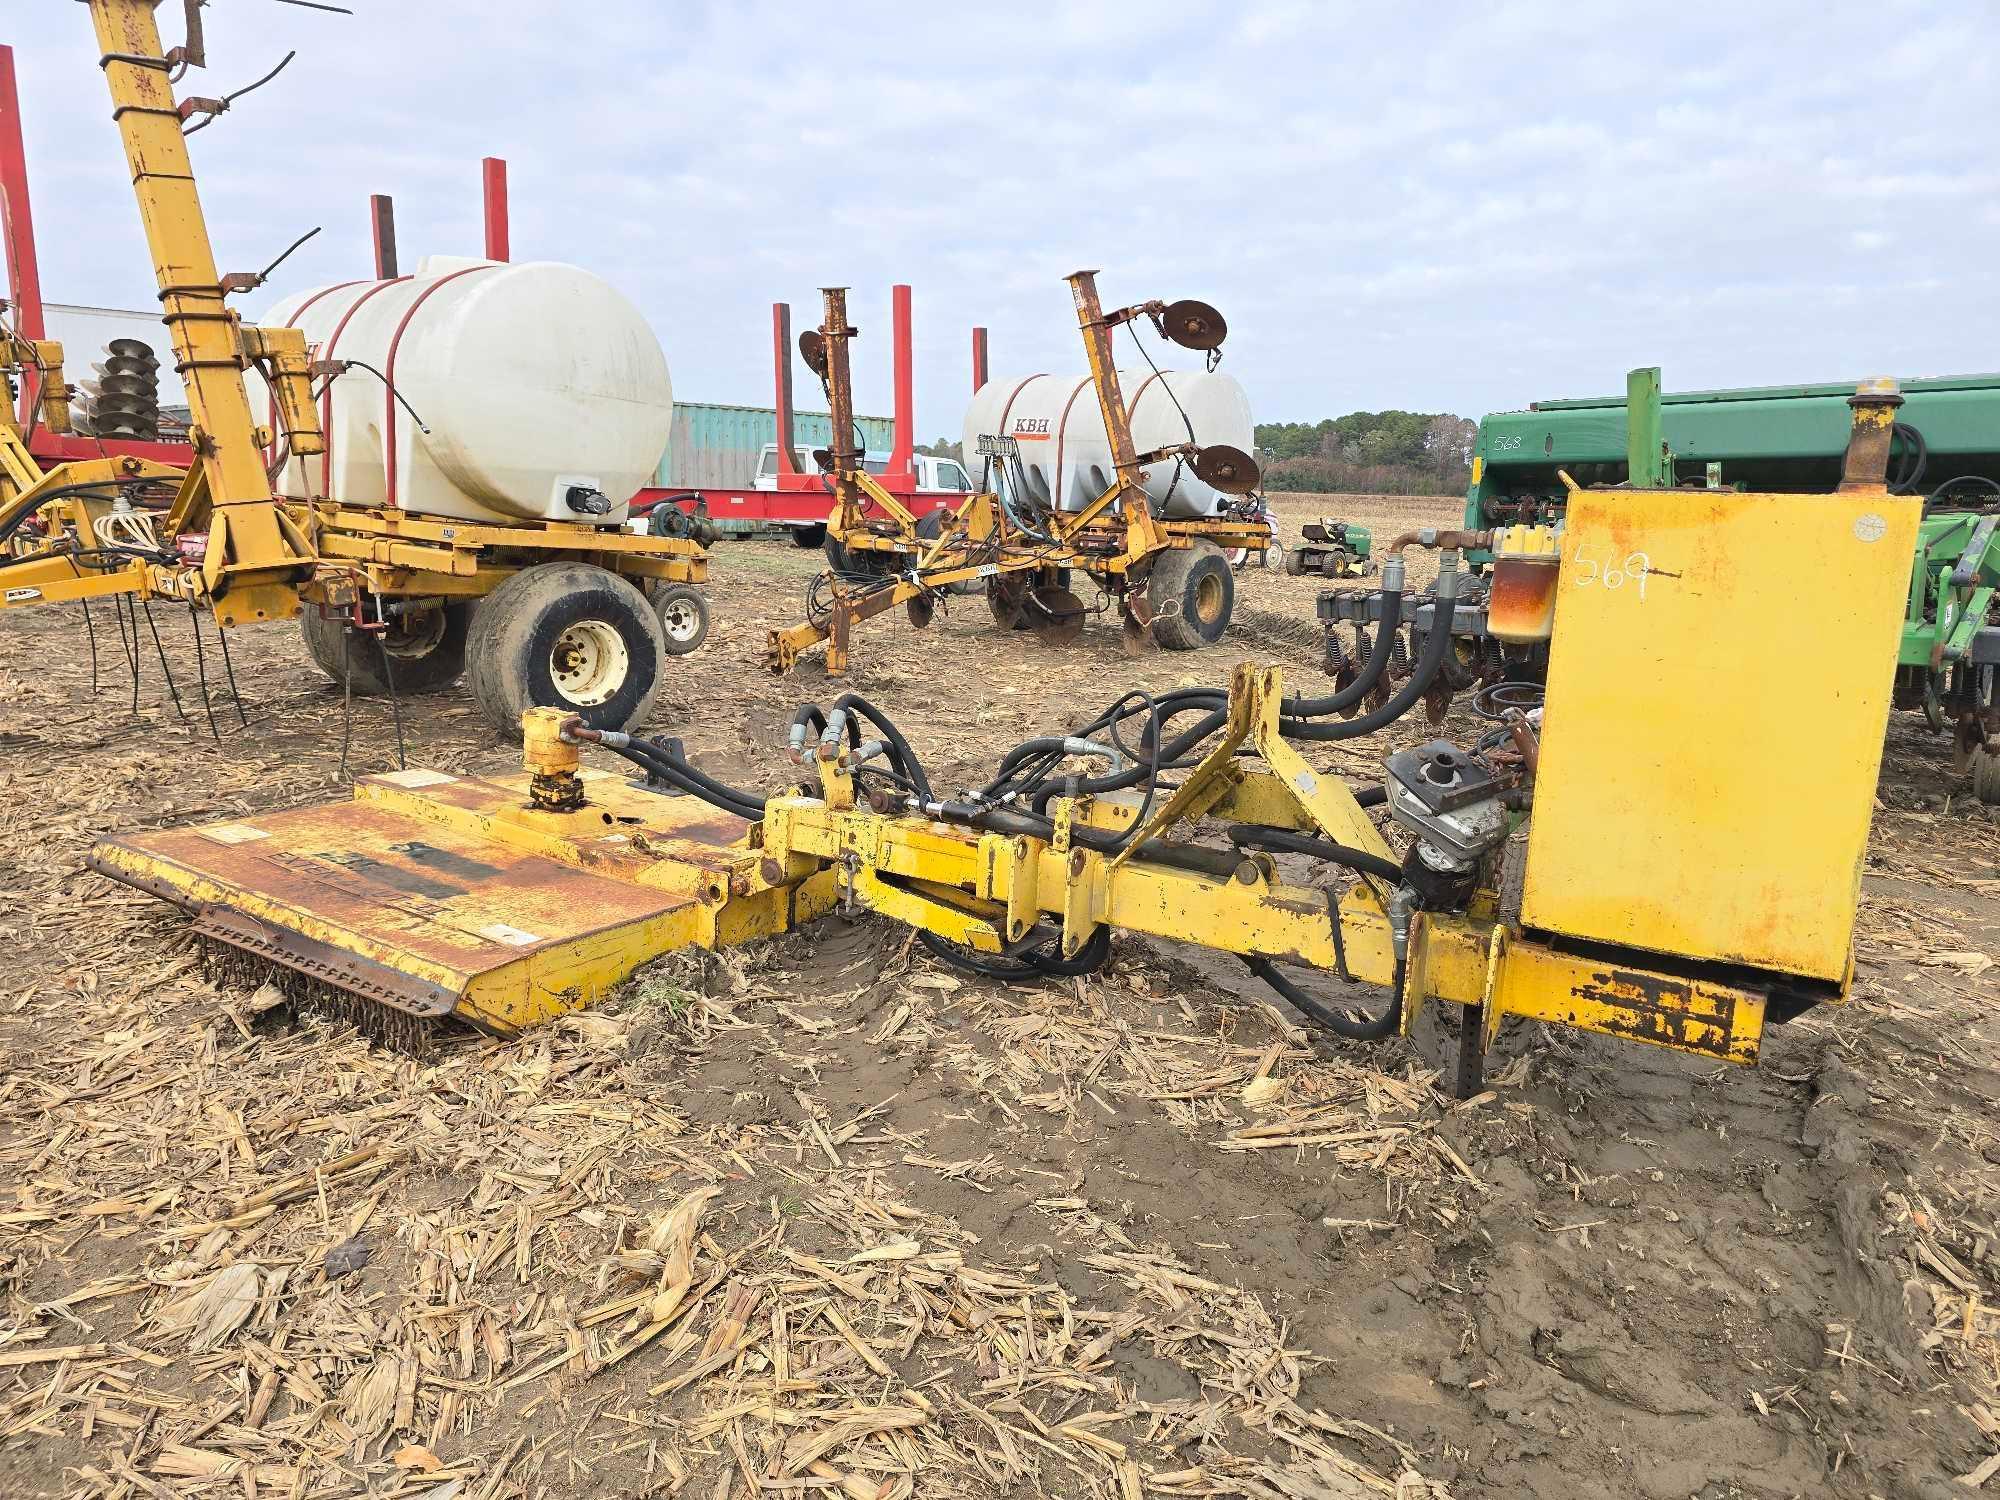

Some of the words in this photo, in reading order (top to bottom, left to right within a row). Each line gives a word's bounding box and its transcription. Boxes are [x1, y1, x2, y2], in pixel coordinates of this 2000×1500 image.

[1014, 418, 1050, 433] KBH
[1493, 436, 1522, 451] 568
[1574, 542, 1650, 600] 569
